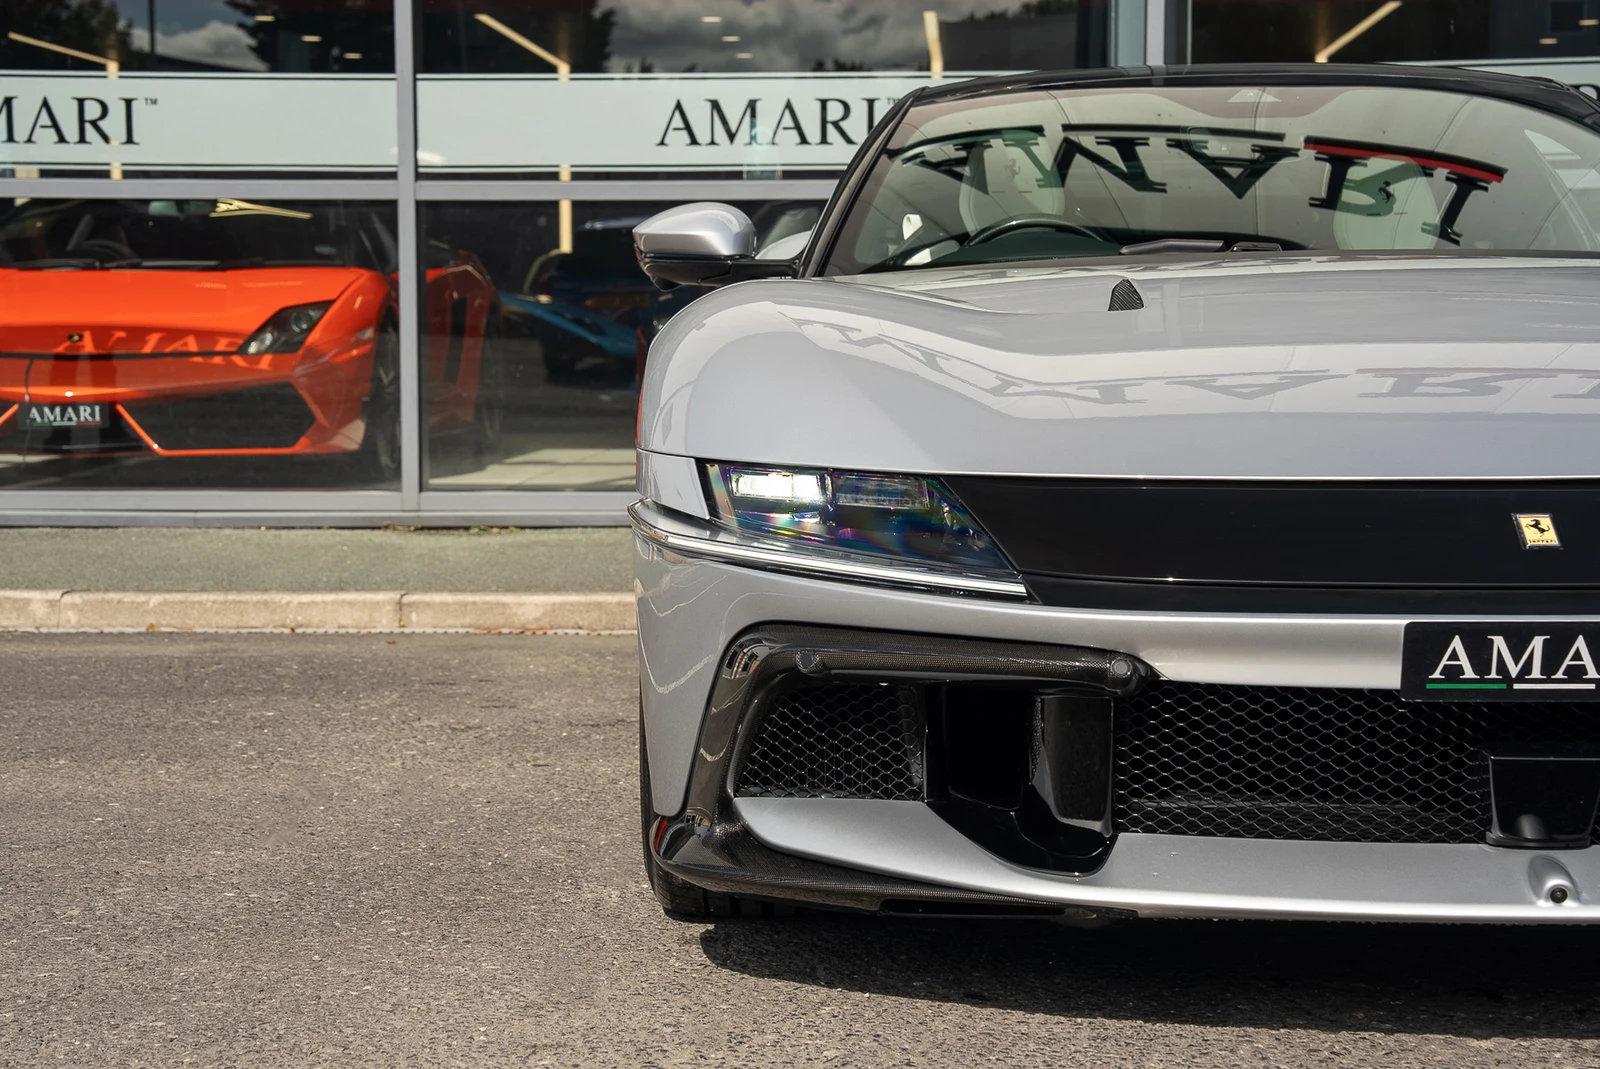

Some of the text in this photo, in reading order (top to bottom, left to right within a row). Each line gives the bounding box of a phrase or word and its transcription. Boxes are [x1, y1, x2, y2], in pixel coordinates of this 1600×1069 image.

[655, 97, 881, 146] AMARI
[28, 404, 102, 423] AMARI
[1428, 634, 1600, 679] AMA
